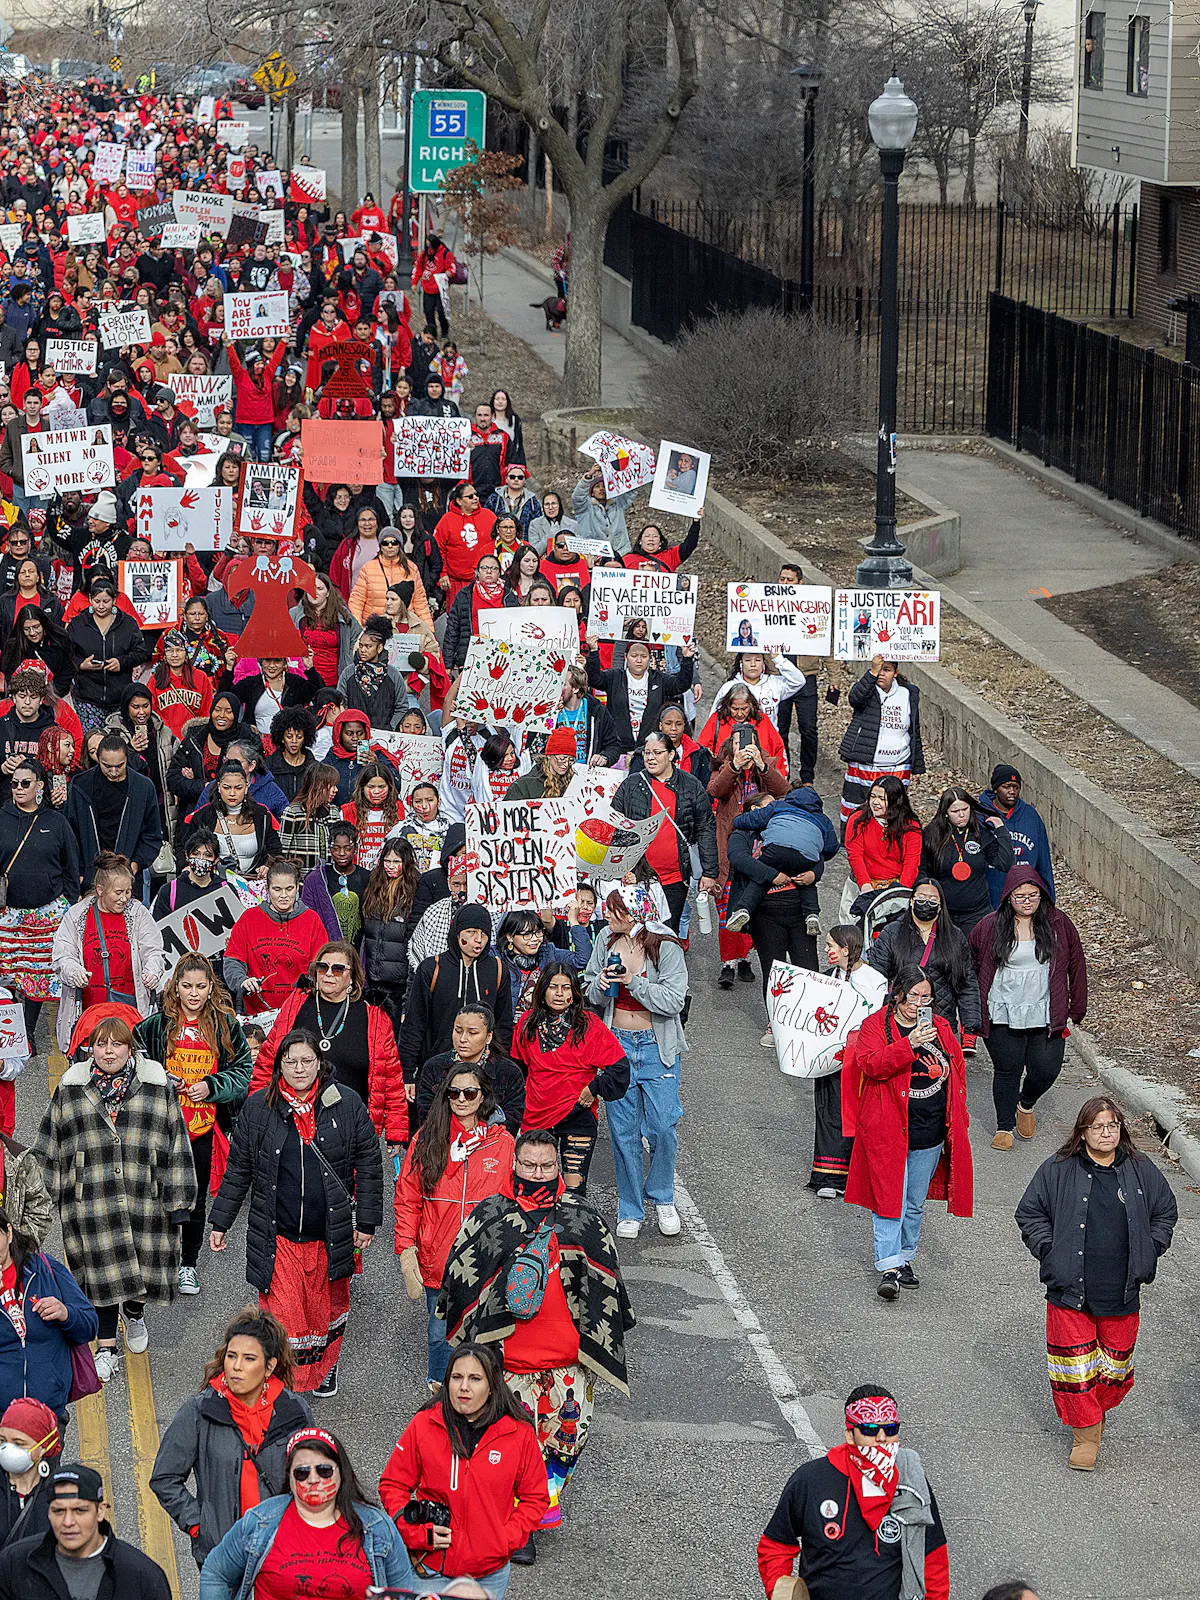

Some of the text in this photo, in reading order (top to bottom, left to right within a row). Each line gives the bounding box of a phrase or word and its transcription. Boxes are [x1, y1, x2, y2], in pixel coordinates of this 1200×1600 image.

[435, 115, 460, 132] 55
[422, 168, 446, 182] LA
[186, 194, 224, 206] NO MORE
[180, 205, 210, 214] STOLEN
[232, 298, 250, 307] YOU
[232, 309, 251, 319] ARE
[108, 314, 138, 328] BRING
[232, 319, 250, 328] NOT
[114, 323, 135, 332] THEM
[231, 325, 288, 337] FORGOTTEN
[107, 330, 147, 346] HOME
[50, 341, 94, 352] JUSTICE
[56, 359, 83, 371] MMIWR
[171, 376, 219, 393] MMIW
[197, 393, 228, 406] MMIW
[46, 430, 87, 445] MMIWR
[308, 427, 360, 446] TAKE
[37, 448, 96, 465] SILENT NO
[309, 456, 337, 466] PAIN
[398, 459, 417, 471] OUR
[250, 465, 297, 480] MMIWR
[55, 472, 85, 486] MORE
[128, 562, 172, 573] MMIWR
[633, 575, 671, 589] FIND
[593, 587, 694, 604] NEVAEH LEIGH
[764, 585, 796, 596] BRING
[616, 605, 671, 617] KINGBIRD
[731, 599, 831, 614] NEVAEH KINGBIRD
[851, 592, 934, 625] JUSTICE FOR ARI
[765, 614, 796, 626] HOME
[666, 625, 690, 633] MISSING
[898, 626, 911, 634] YOU
[890, 642, 920, 650] FORGOTTEN
[479, 806, 541, 836] NO MORE
[480, 838, 544, 868] STOLEN
[475, 867, 560, 906] SISTERS!
